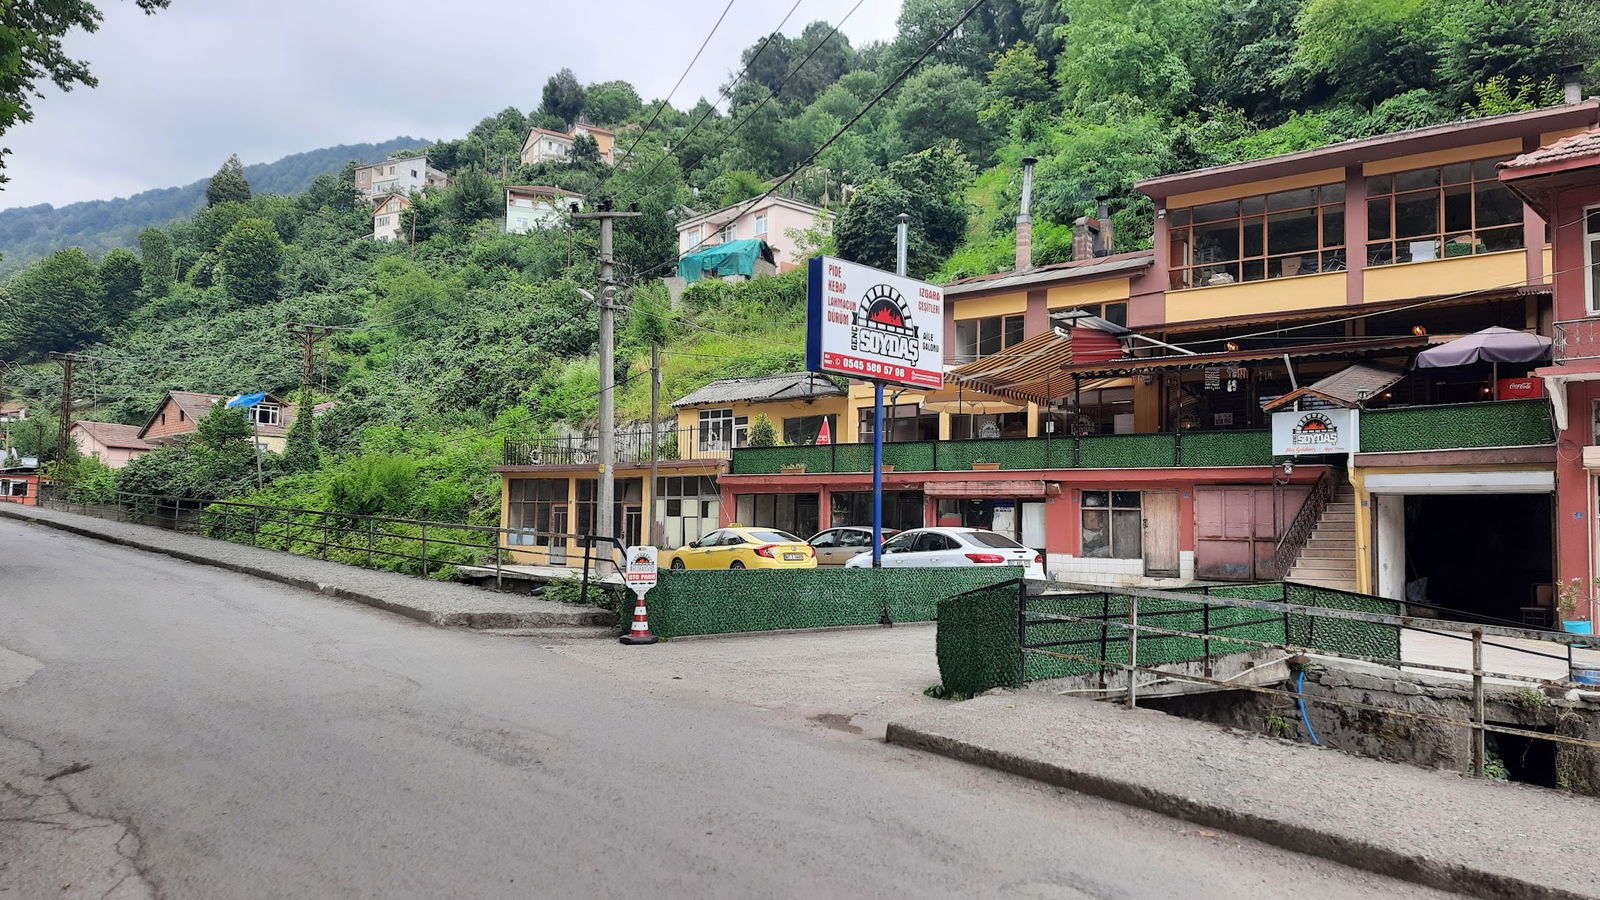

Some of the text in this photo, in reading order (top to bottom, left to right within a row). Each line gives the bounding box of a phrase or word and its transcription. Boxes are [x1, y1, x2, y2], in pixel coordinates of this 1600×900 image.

[828, 263, 842, 278] PİDE
[828, 279, 847, 294] KEBAP
[919, 287, 941, 301] IZGARA
[827, 296, 857, 311] LAHMACUN
[827, 308, 850, 326] DÜRÜM
[859, 328, 919, 367] SOYDAŞ
[843, 357, 864, 370] 0545
[866, 361, 882, 374] 588
[883, 365, 894, 376] 57
[894, 367, 905, 378] 96
